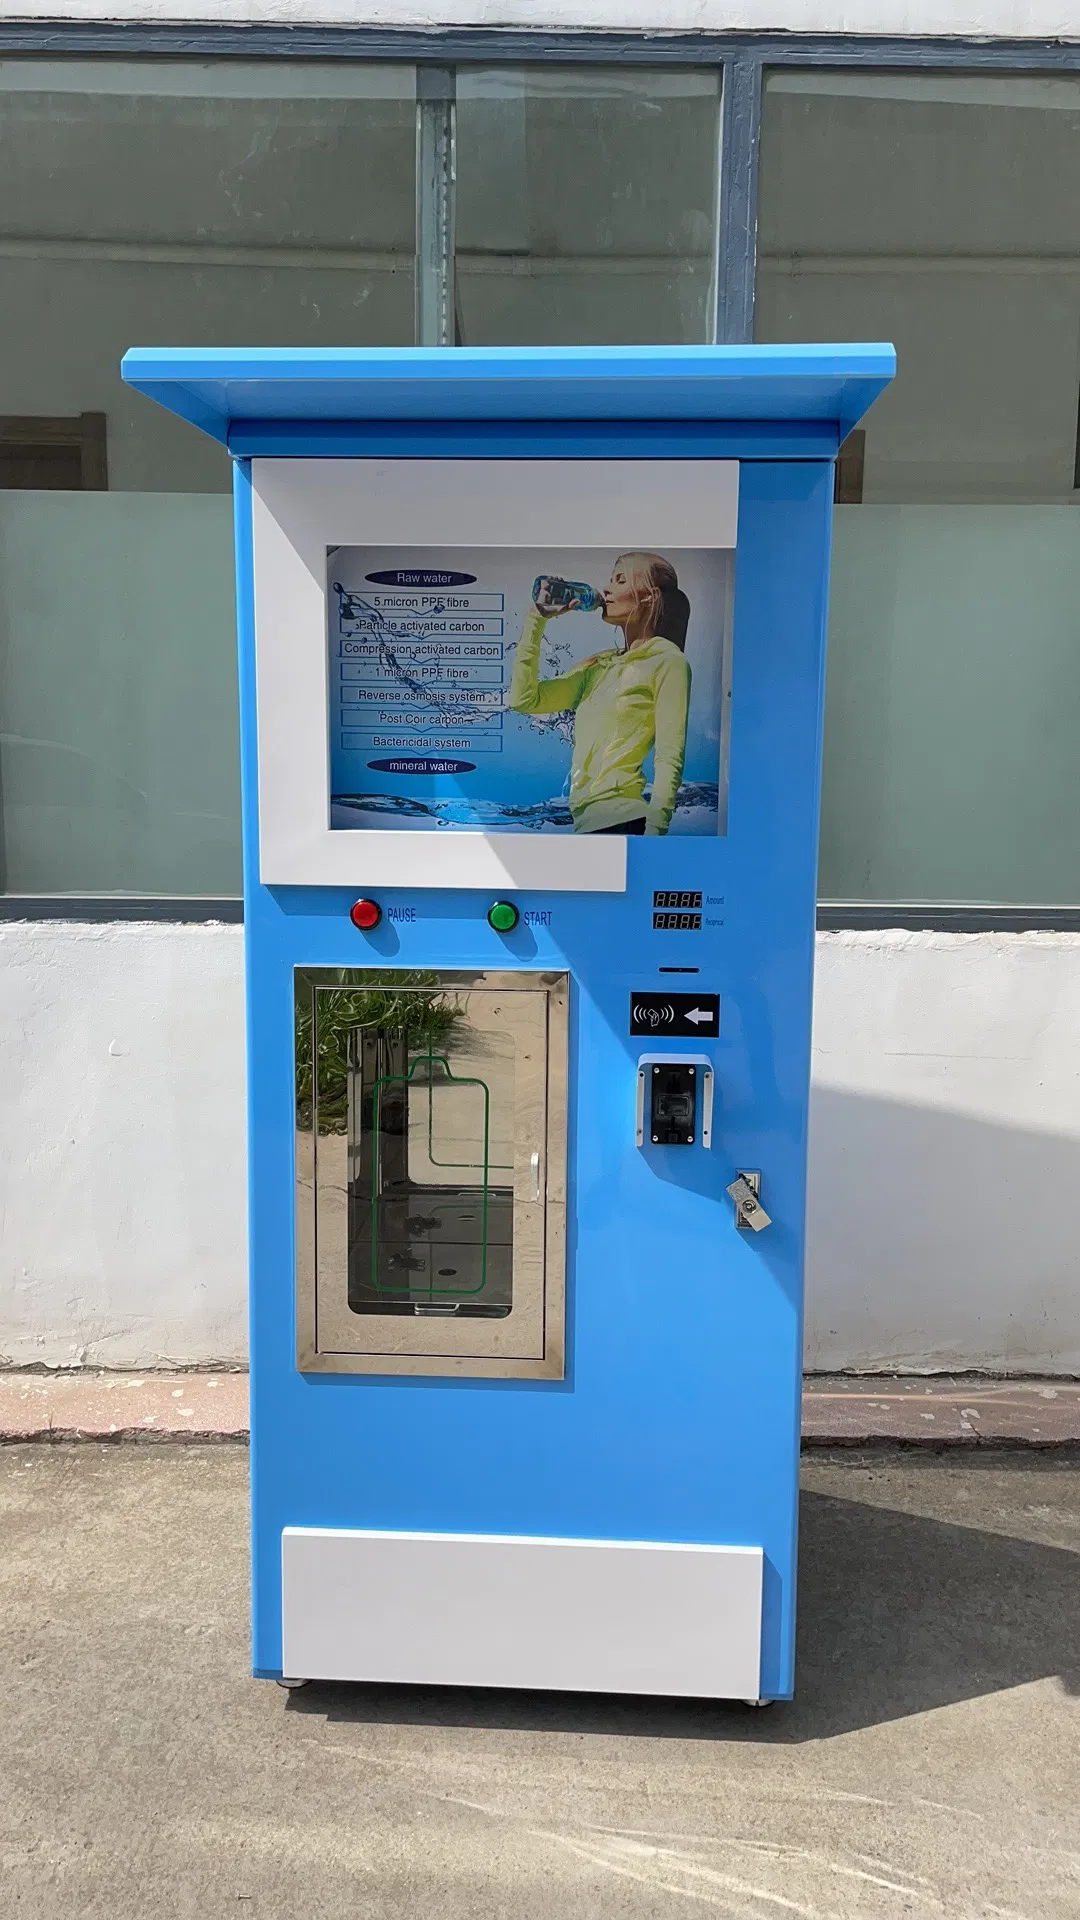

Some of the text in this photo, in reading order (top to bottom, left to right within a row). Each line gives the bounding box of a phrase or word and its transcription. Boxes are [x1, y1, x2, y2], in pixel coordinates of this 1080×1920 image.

[397, 573, 452, 583] Raw water
[374, 598, 381, 607] 5
[383, 598, 418, 607] micron
[447, 598, 469, 608] fibre
[359, 620, 485, 632] Particle activated carbon
[344, 643, 499, 655] Compression activated carbon
[375, 668, 469, 678] 1 micron PPF fibre
[358, 691, 485, 703] Reverse osmosis system
[380, 713, 464, 724] Post Coir carbon
[373, 737, 471, 749] Bactericidal system
[390, 761, 458, 771] mineral water
[706, 896, 724, 904] Amount
[387, 908, 417, 923] PAUSE
[523, 911, 552, 926] START
